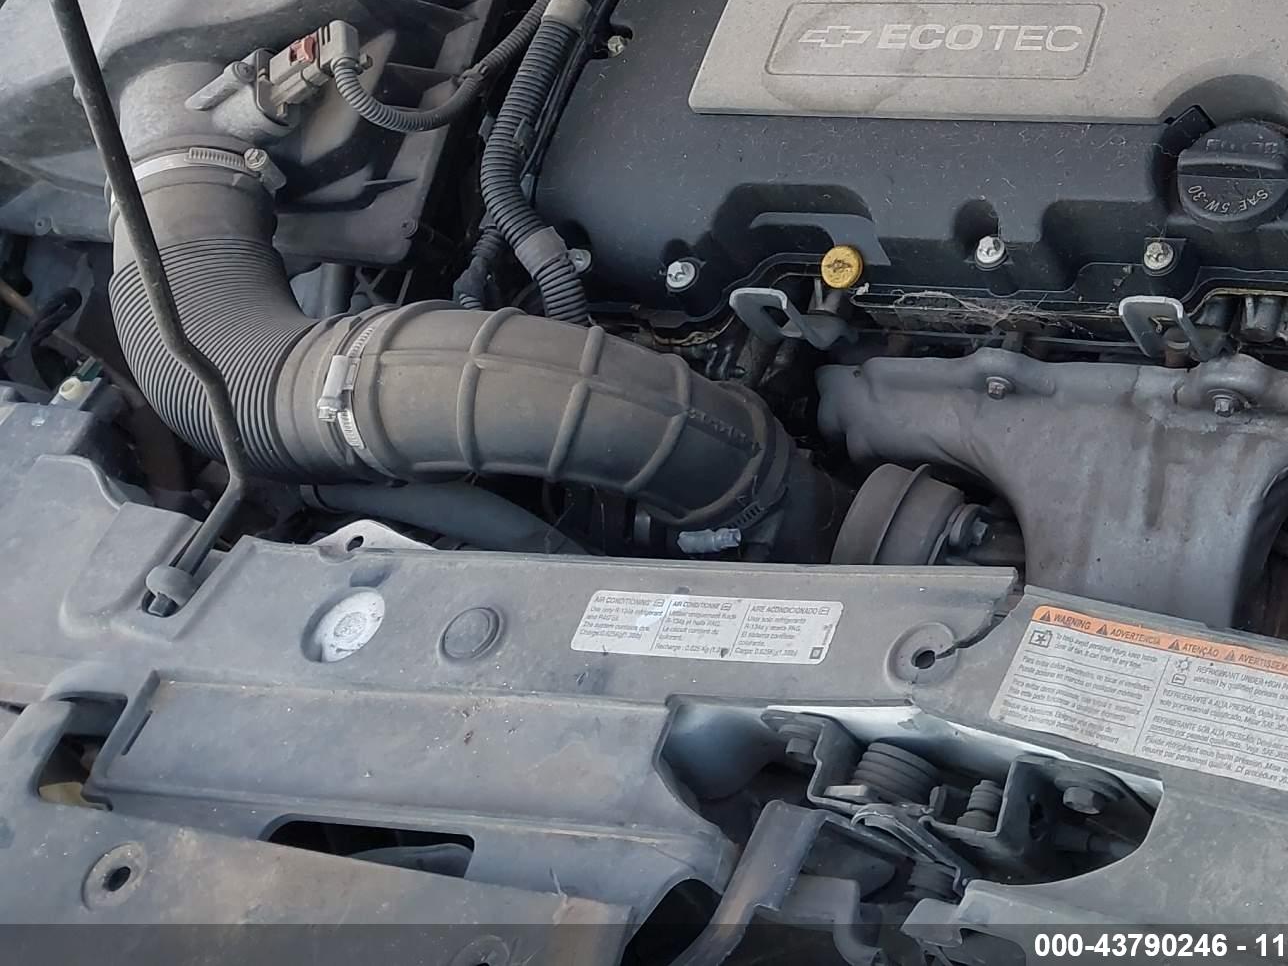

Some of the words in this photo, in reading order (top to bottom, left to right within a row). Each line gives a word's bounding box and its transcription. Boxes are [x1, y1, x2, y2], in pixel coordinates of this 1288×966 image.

[877, 23, 1083, 52] ECOTEC
[1188, 185, 1231, 213] 5W-30
[1240, 189, 1269, 211] SAE
[1053, 614, 1092, 629] WARNING
[1109, 627, 1162, 645] ADVERTENCIA
[1181, 641, 1221, 658] ATENÇÃO
[1196, 665, 1239, 680] REFRIGERANT
[1239, 674, 1265, 685] UNDER
[1265, 679, 1281, 688] HIGH
